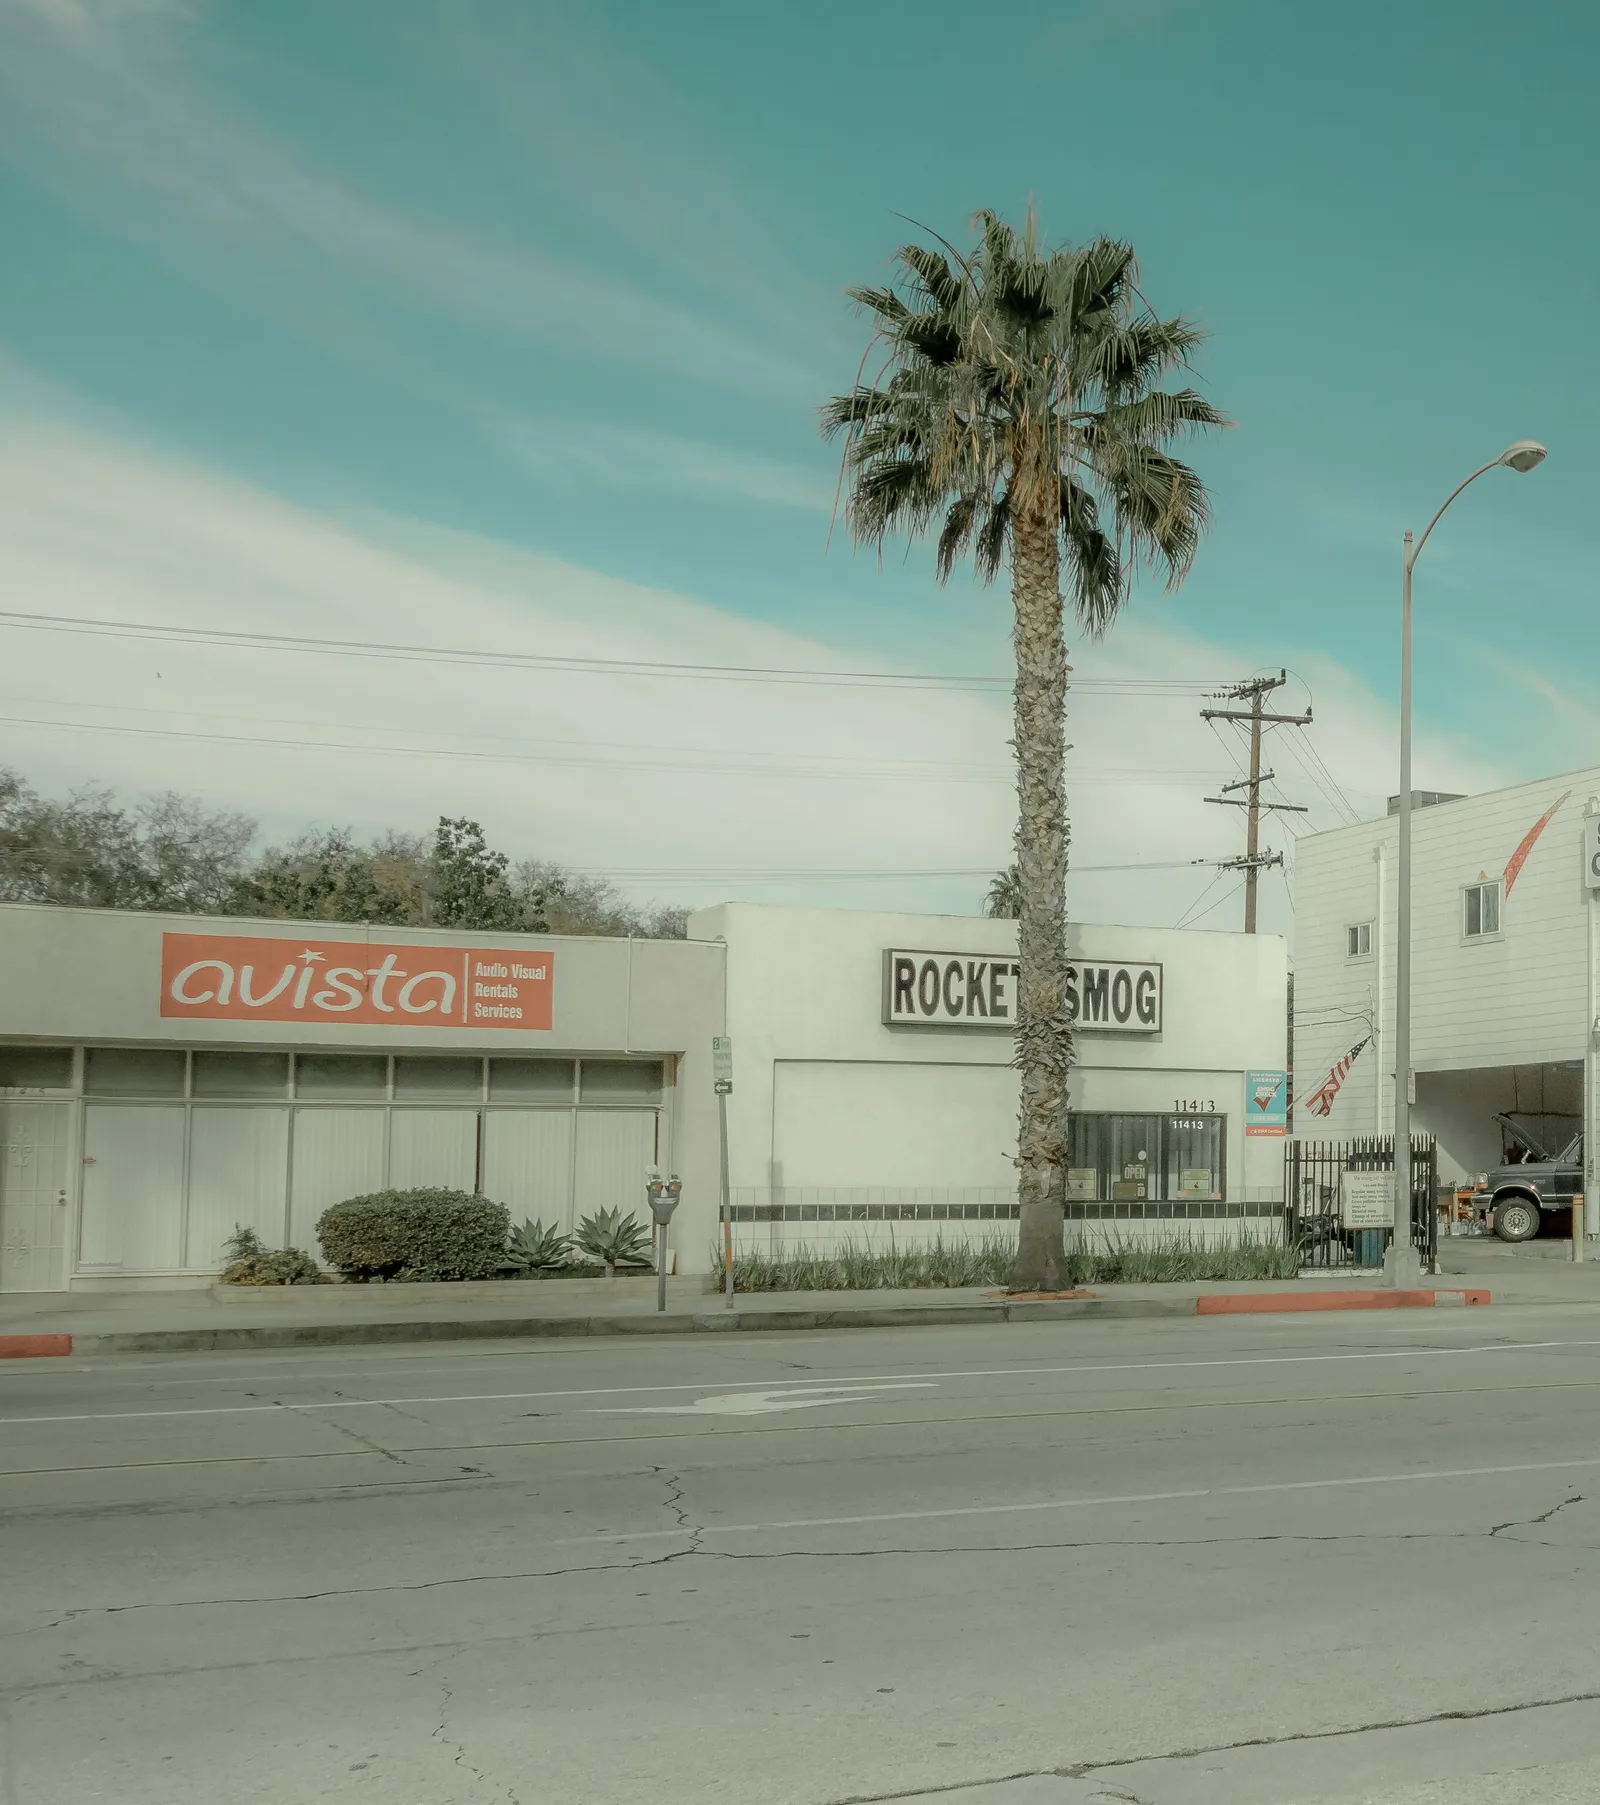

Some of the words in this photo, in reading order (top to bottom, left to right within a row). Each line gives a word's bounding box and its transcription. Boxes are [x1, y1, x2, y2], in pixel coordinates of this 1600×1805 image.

[475, 962, 508, 978] Audio
[511, 963, 546, 980] Visual
[171, 948, 457, 1015] avista
[475, 982, 519, 999] Rentals
[475, 1002, 523, 1019] Services
[1173, 1099, 1216, 1113] 11413
[1172, 1120, 1204, 1130] 11413
[1124, 1166, 1146, 1179] OPEN
